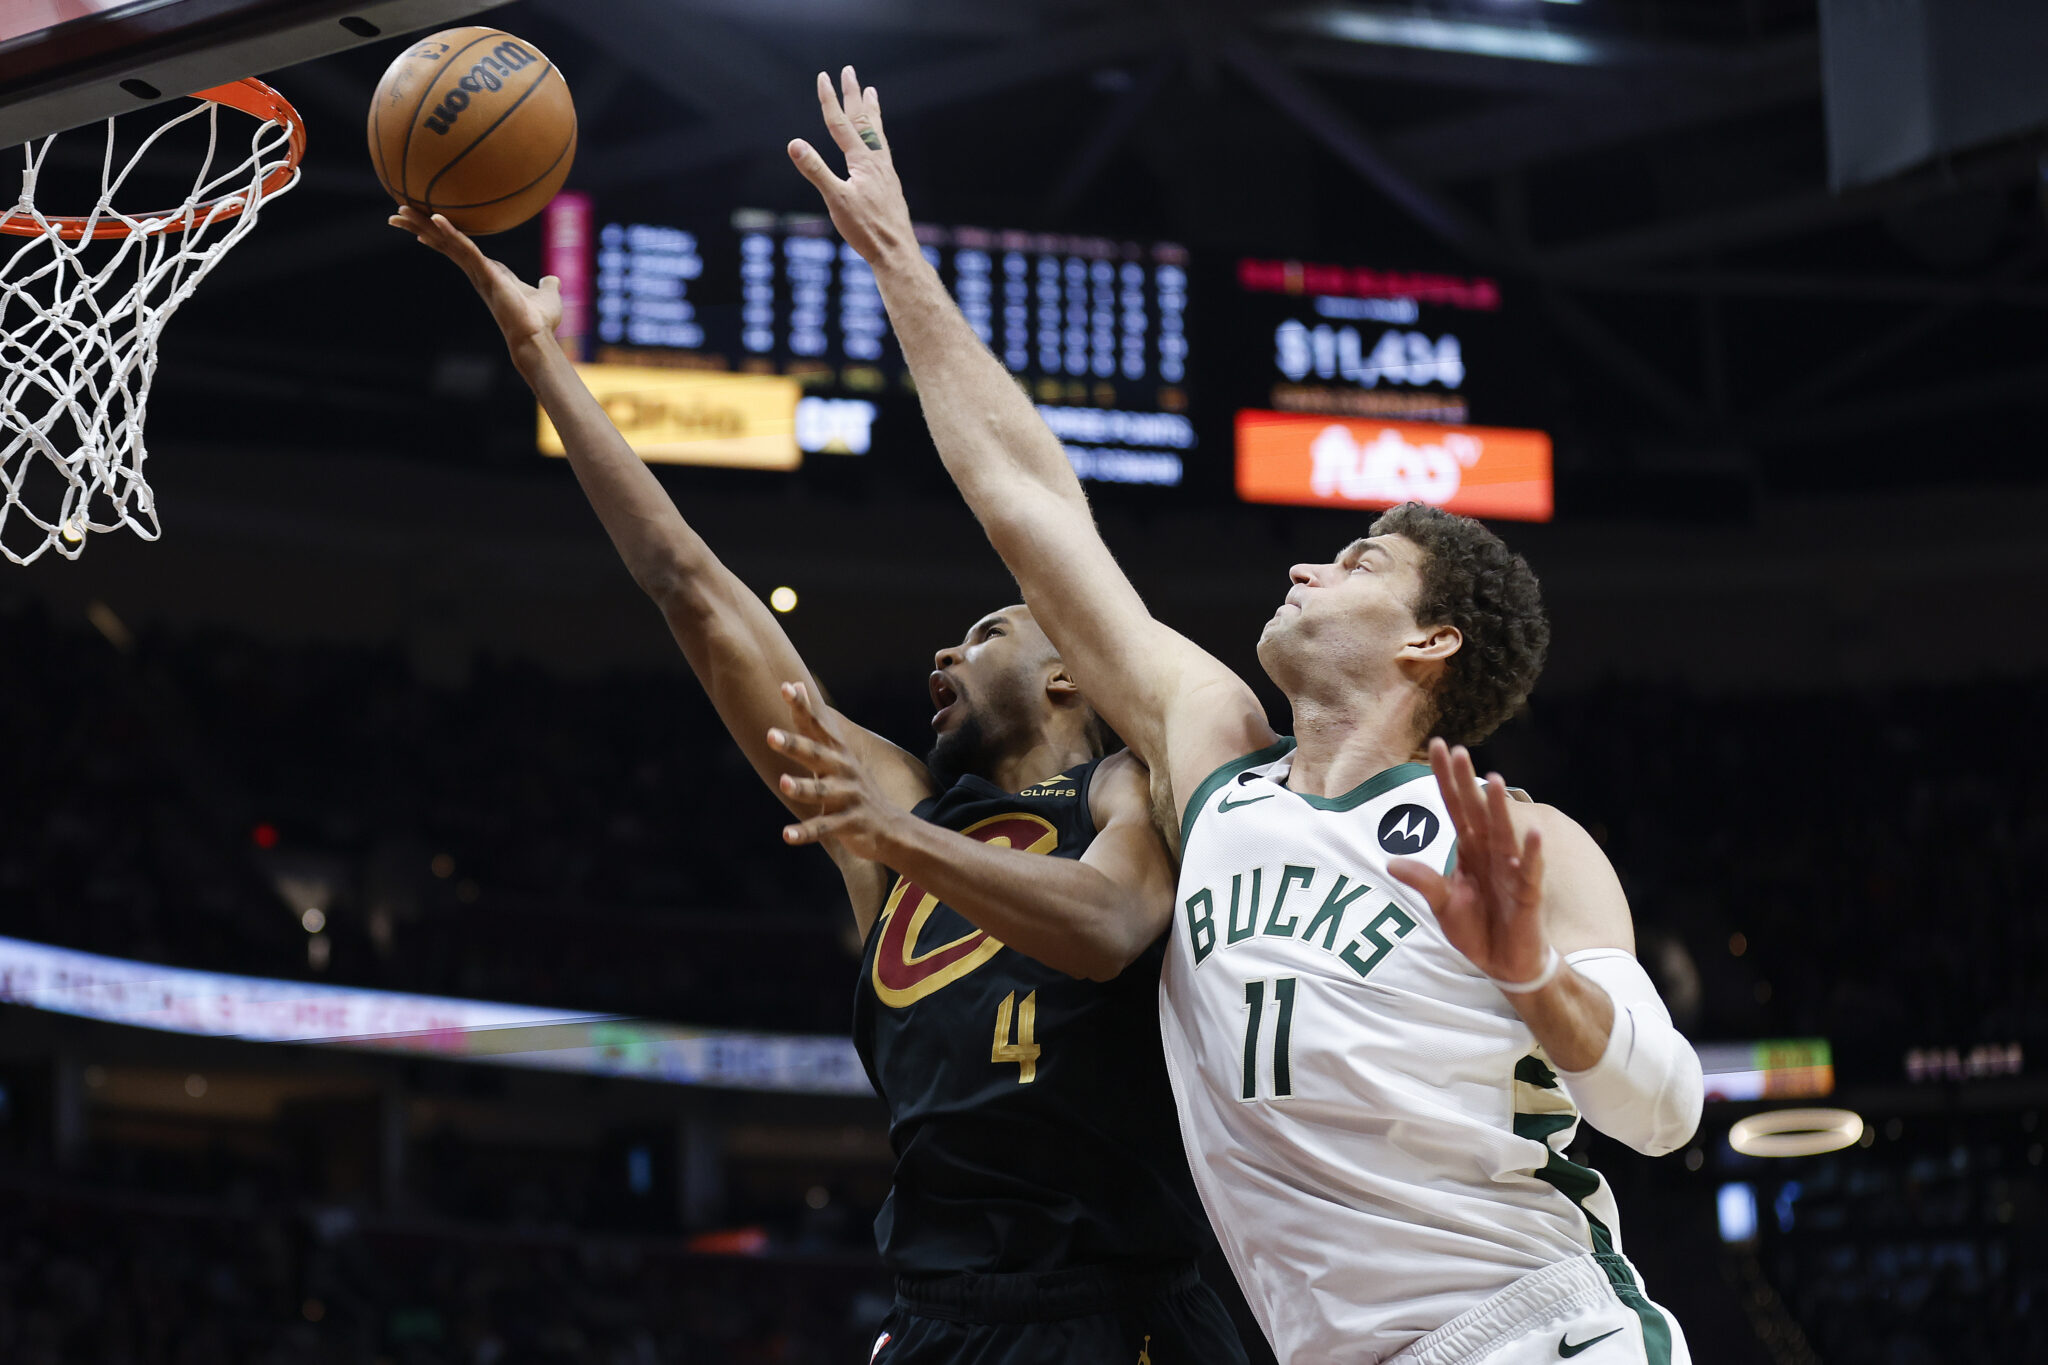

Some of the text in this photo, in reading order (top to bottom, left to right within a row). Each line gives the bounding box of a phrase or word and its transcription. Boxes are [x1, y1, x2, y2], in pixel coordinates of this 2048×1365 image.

[423, 40, 539, 136] Wilson
[1275, 318, 1465, 388] $11,434
[1020, 789, 1077, 797] CLIFFS
[1185, 863, 1421, 981] BUCKS
[991, 989, 1041, 1084] 4
[1240, 976, 1298, 1103] 11
